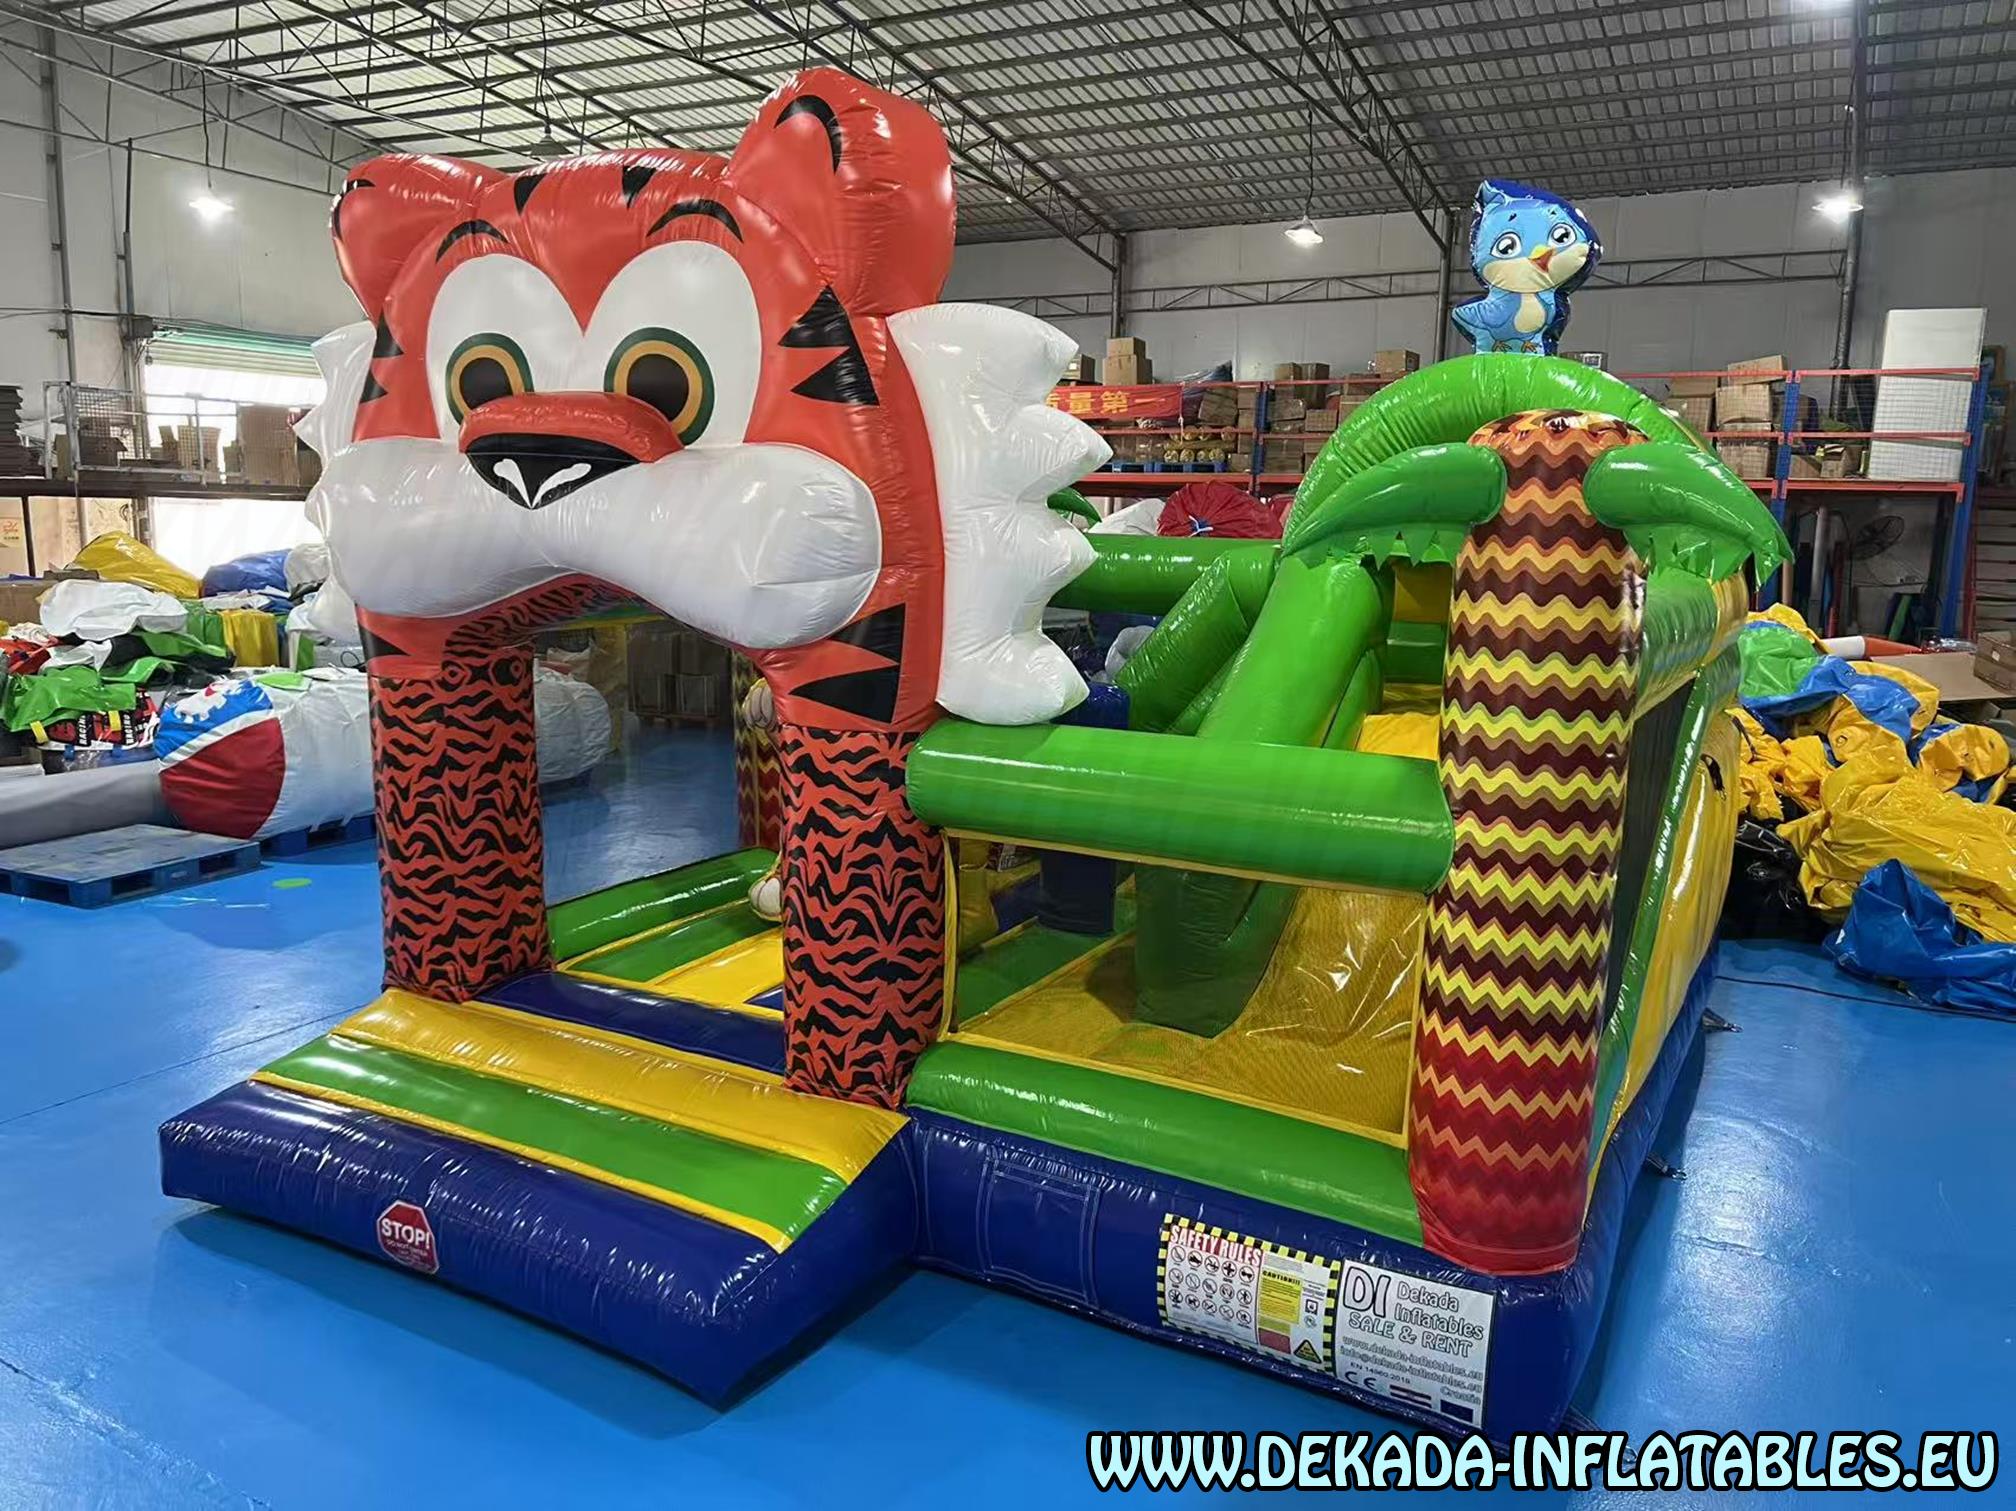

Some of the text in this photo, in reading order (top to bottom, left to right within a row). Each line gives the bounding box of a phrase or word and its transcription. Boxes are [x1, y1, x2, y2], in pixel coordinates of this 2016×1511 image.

[381, 1218, 430, 1250] STOP!
[1170, 1225, 1221, 1255] SAFETY
[1219, 1238, 1263, 1268] RULES
[1343, 1266, 1391, 1318] DI
[1397, 1281, 1459, 1313] Dekada
[1349, 1312, 1474, 1359] SALE & RENT
[1394, 1303, 1484, 1341] Inflatables
